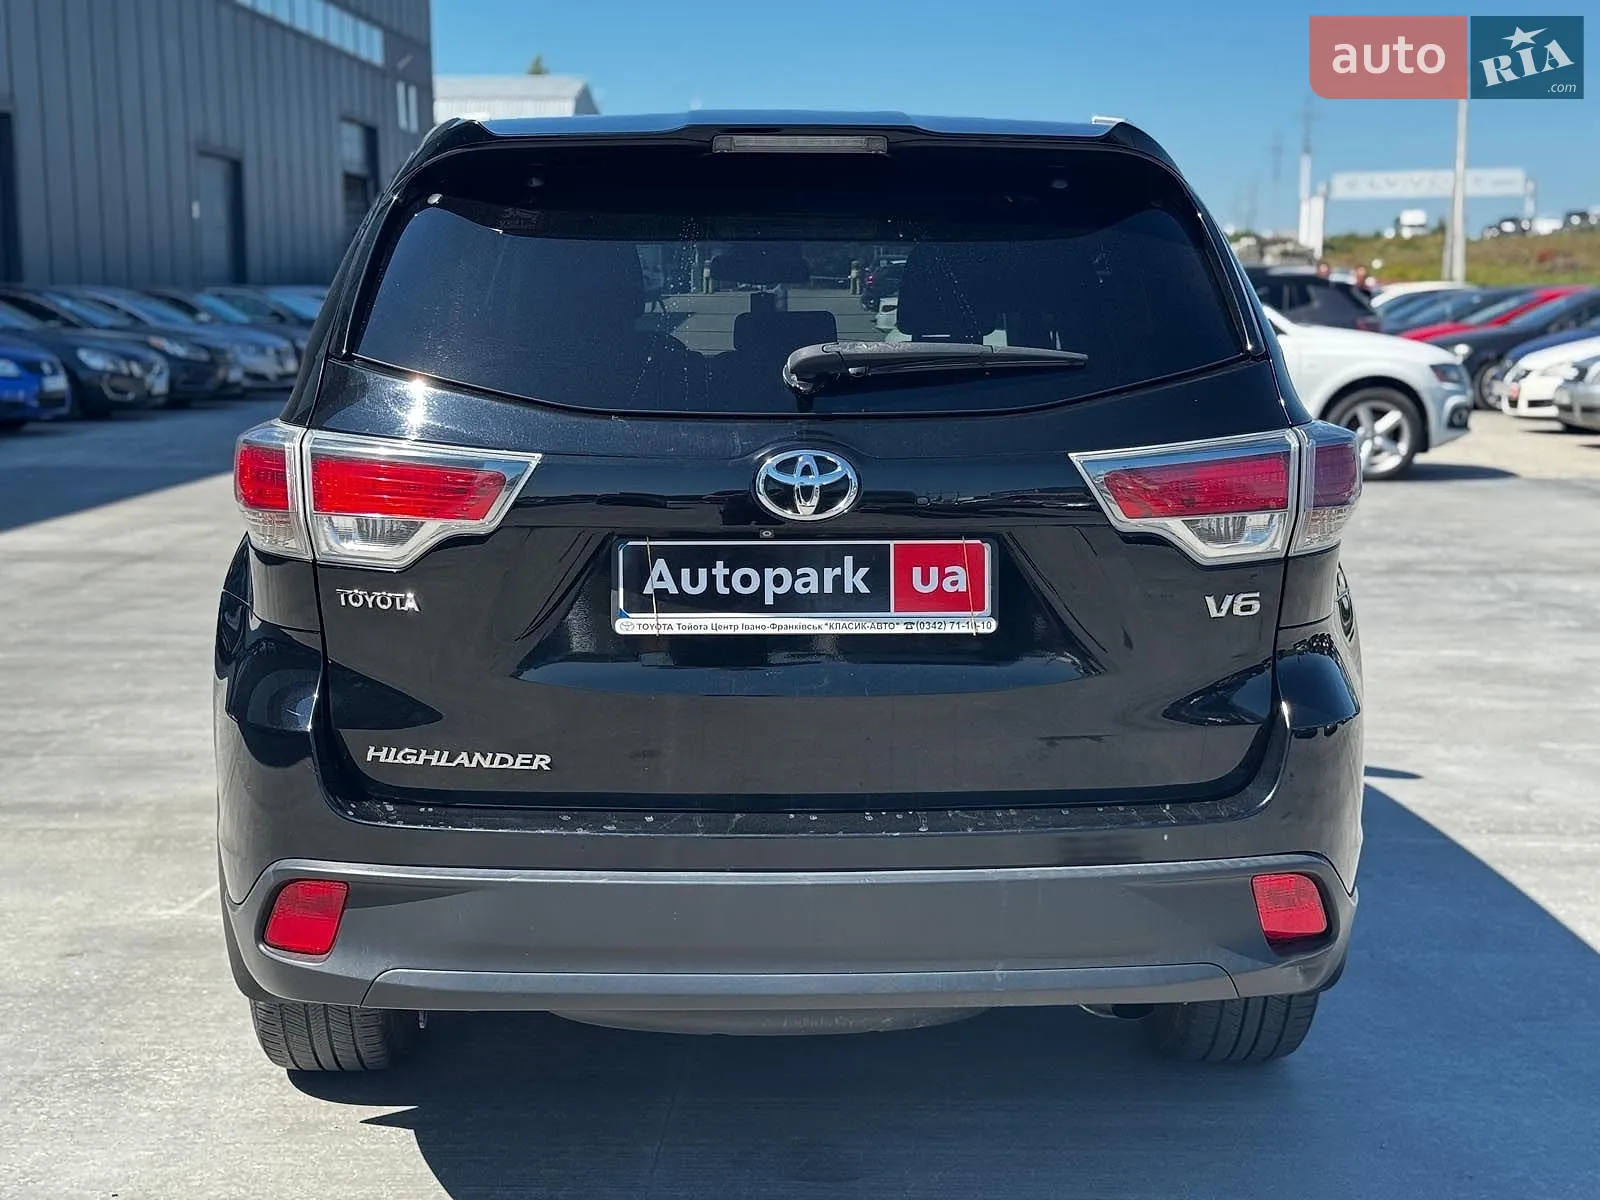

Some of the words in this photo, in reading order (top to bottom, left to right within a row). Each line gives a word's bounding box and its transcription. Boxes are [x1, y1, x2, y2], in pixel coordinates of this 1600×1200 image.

[642, 555, 871, 605] Autopark
[911, 564, 967, 592] ua
[335, 588, 421, 612] TOYOTA
[1204, 591, 1261, 618] V6
[636, 622, 674, 631] TOYOTA
[677, 622, 708, 631] Тойота
[711, 622, 739, 633] Центр
[741, 621, 823, 633] Івано-Франківськ
[916, 620, 947, 632] (0342)
[366, 745, 552, 771] HIGHLANDER
